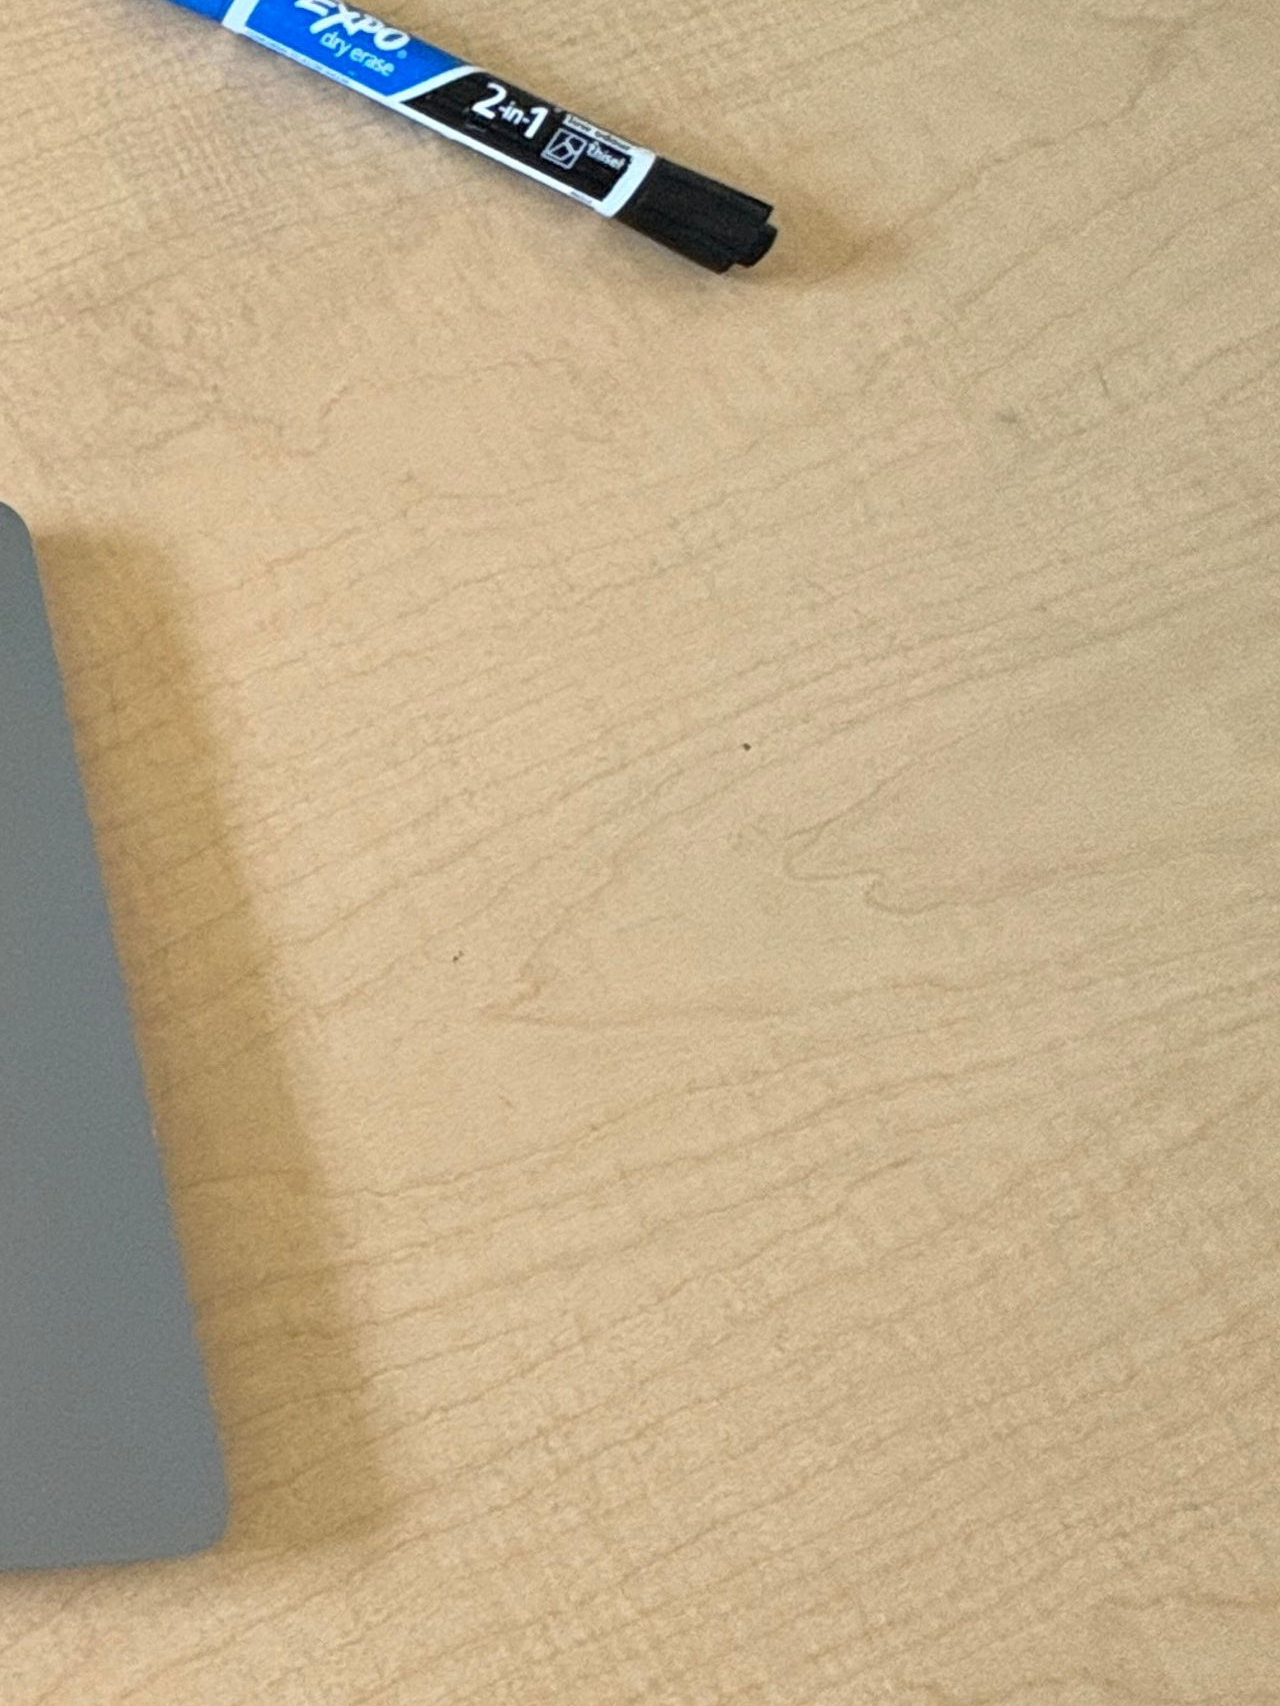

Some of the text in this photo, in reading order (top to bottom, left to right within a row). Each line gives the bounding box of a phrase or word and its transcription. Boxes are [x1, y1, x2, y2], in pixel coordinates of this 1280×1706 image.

[319, 31, 352, 59] dry
[349, 47, 395, 77] erase
[471, 82, 549, 139] 2-in-1
